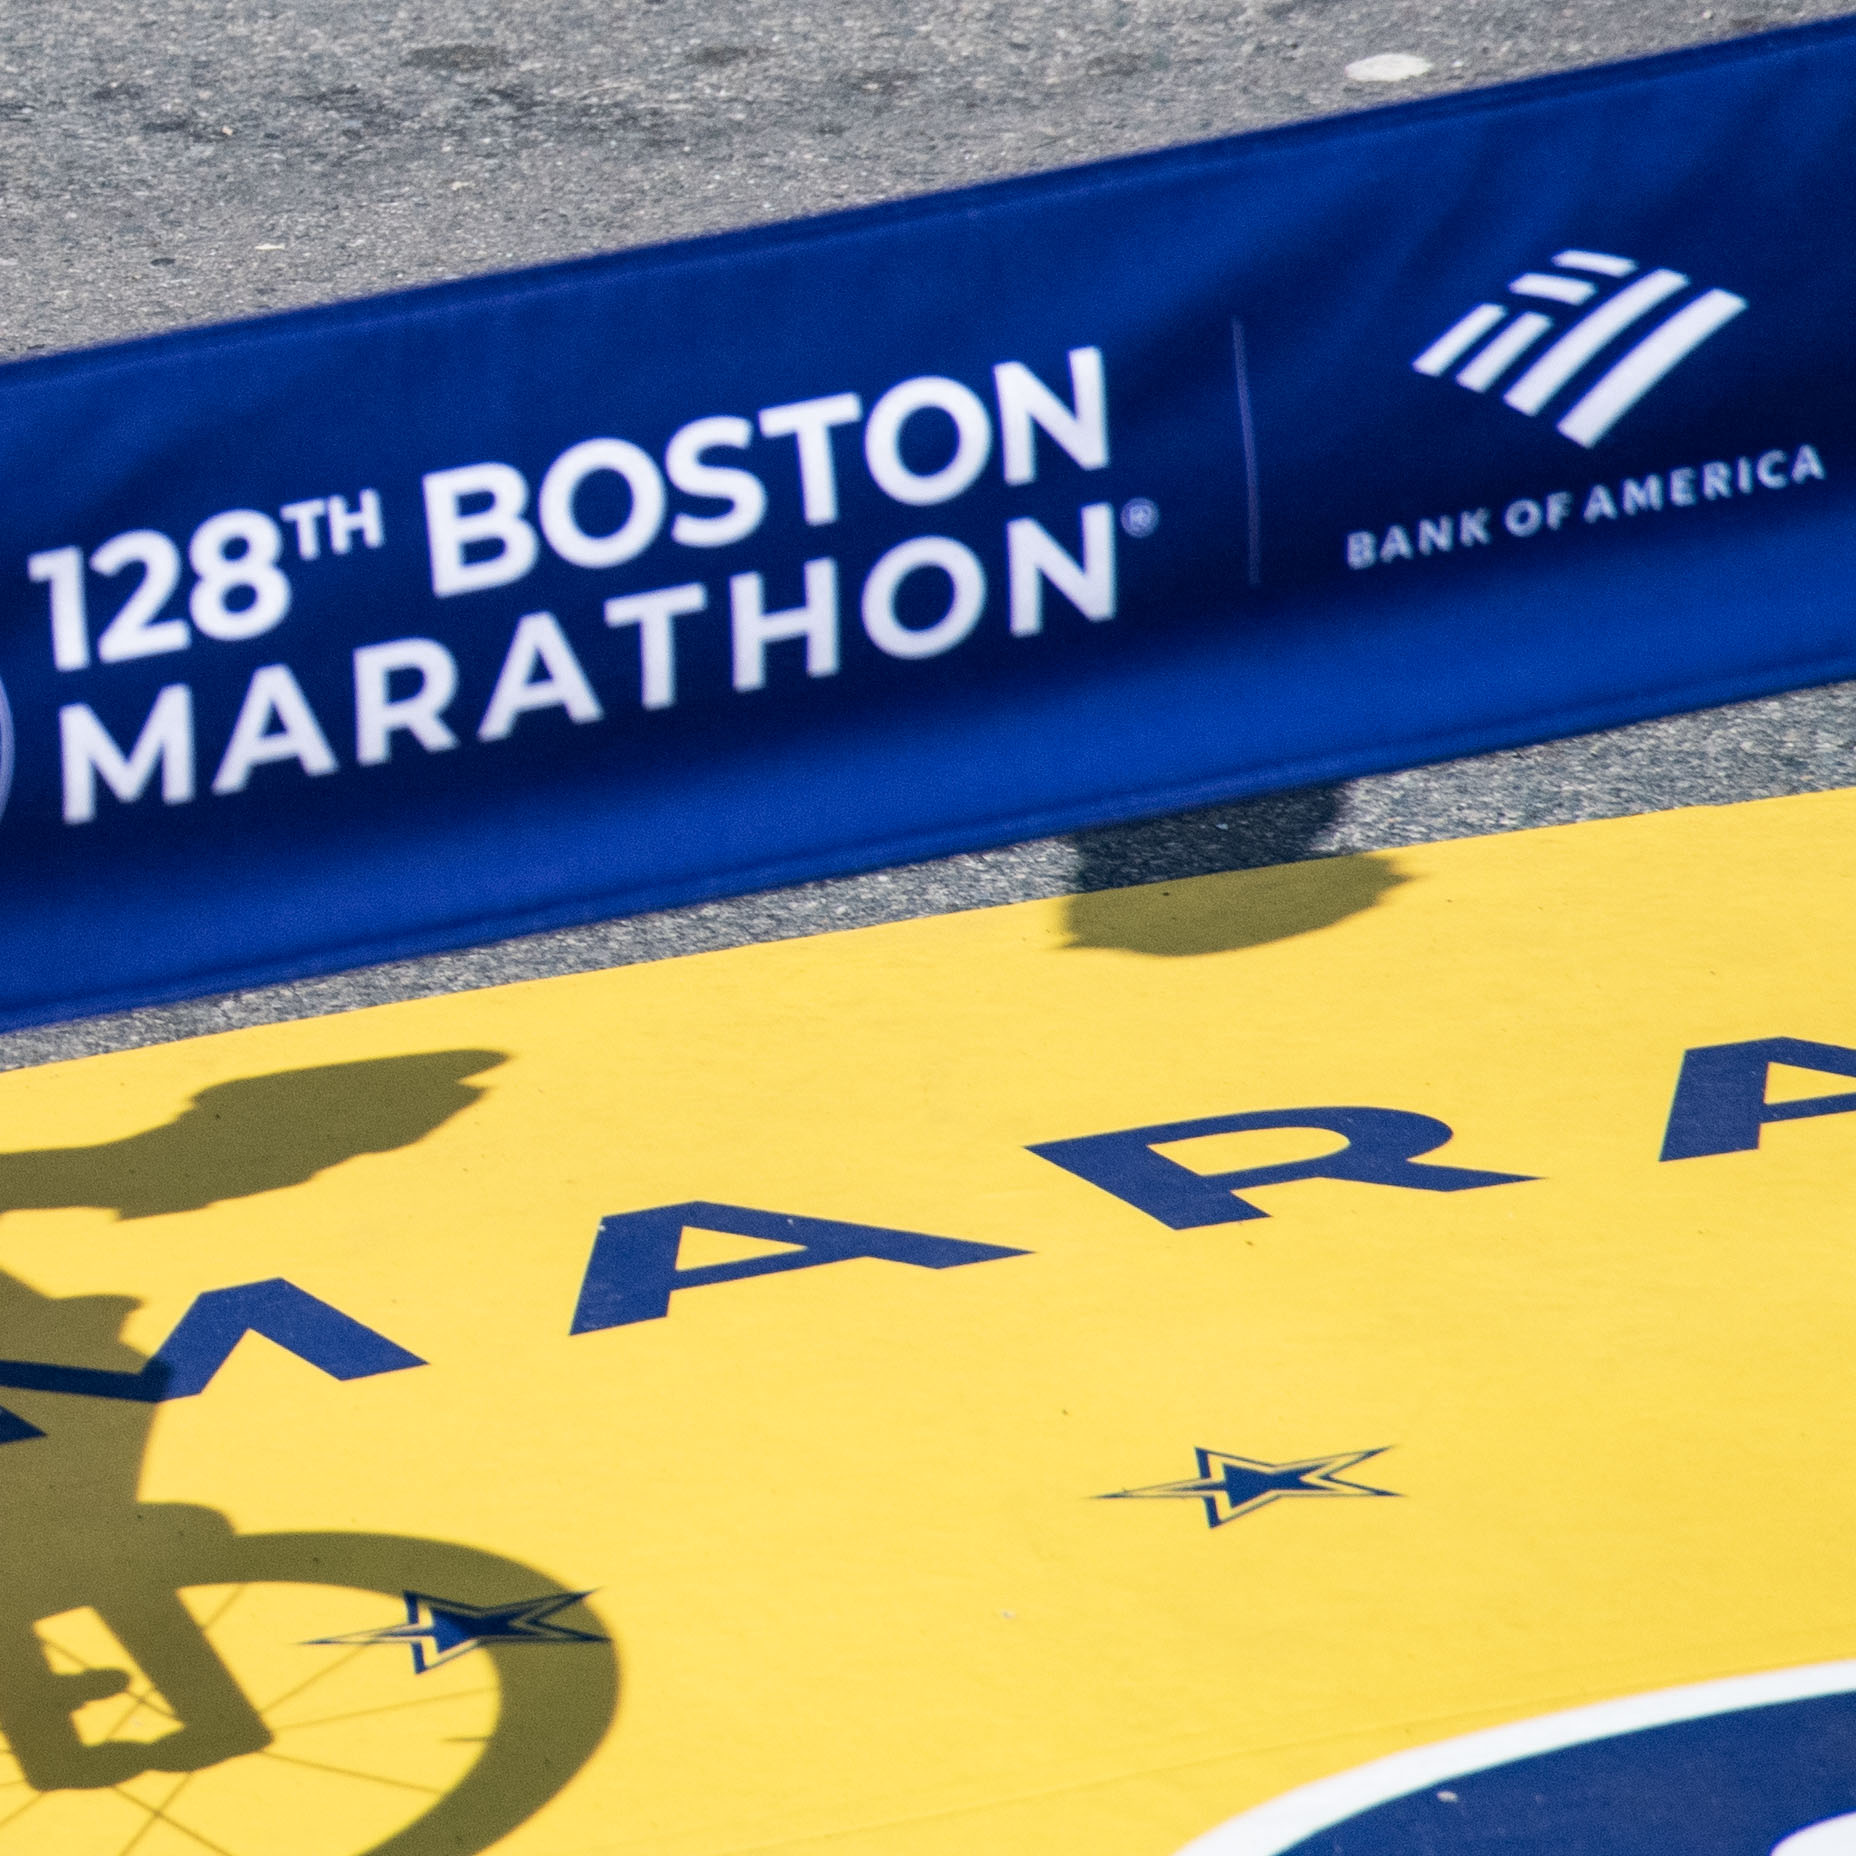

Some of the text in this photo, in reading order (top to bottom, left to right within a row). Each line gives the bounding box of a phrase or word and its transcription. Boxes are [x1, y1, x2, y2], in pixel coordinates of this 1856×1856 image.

[29, 346, 1109, 670] 128TH BOSTON
[1345, 444, 1825, 570] BANK OF AMERICA
